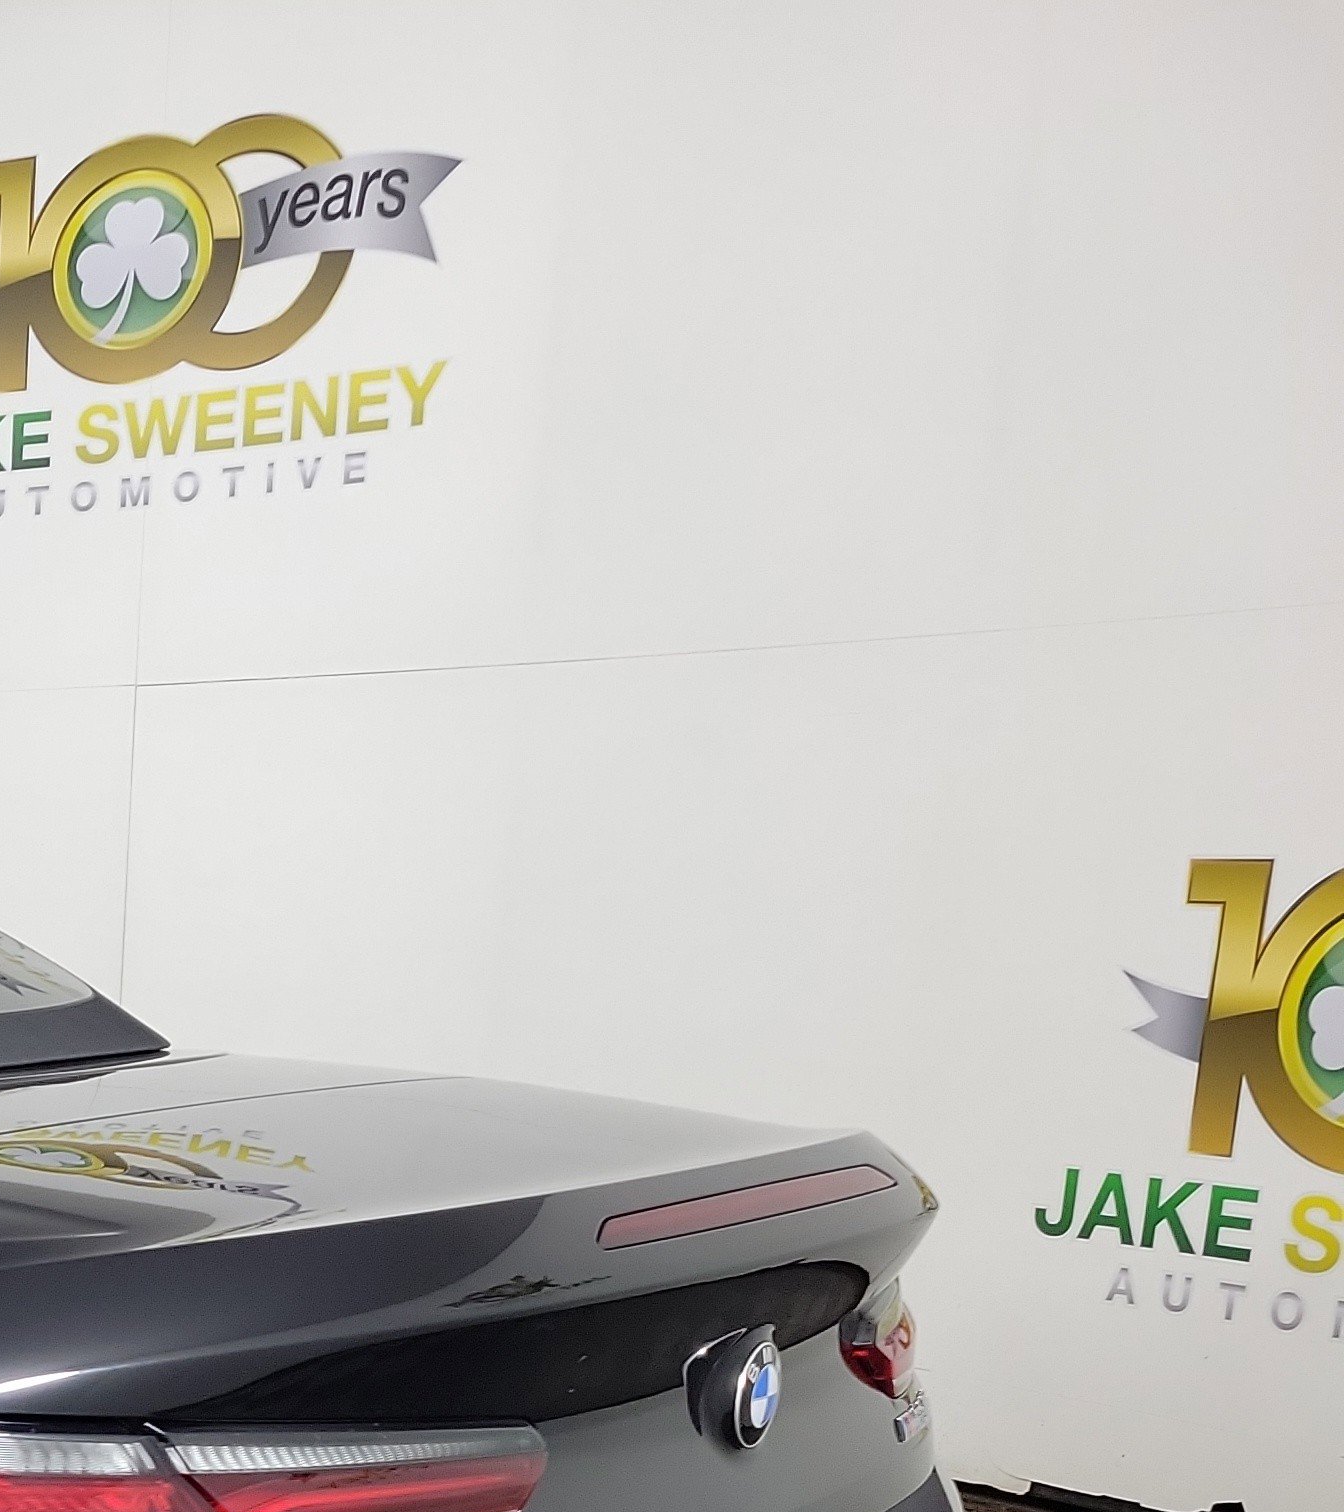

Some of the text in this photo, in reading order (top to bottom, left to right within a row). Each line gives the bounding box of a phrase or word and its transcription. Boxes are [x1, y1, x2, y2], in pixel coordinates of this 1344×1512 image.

[252, 165, 410, 255] years
[74, 359, 448, 465] SWEENEY
[1034, 1167, 1260, 1263] JAKE
[1105, 1267, 1344, 1339] AUTO
